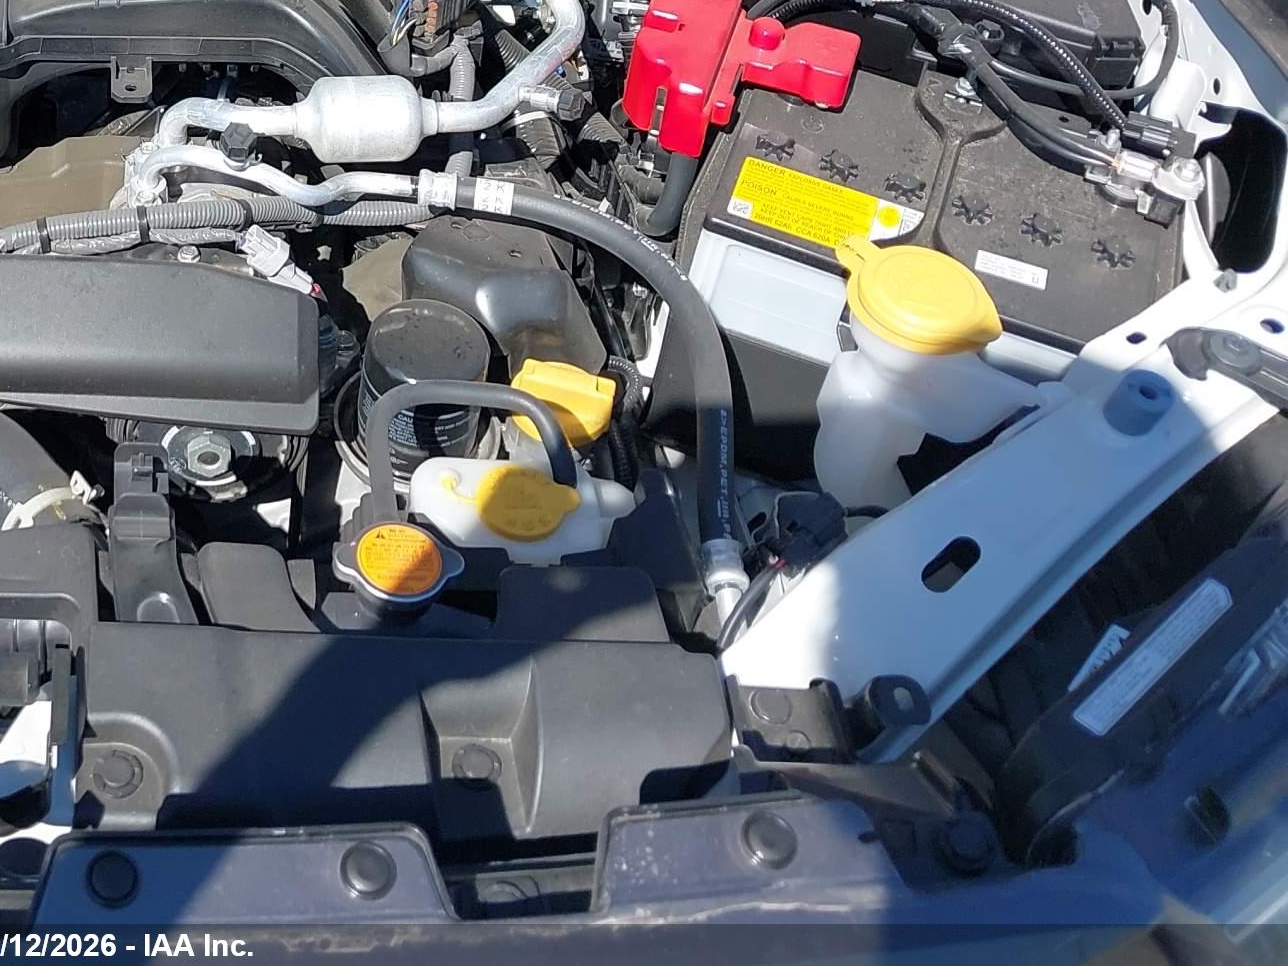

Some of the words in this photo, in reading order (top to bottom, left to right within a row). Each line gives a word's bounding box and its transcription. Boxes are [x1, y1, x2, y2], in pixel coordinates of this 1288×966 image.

[747, 158, 786, 176] DANGER
[740, 178, 777, 196] POISON
[776, 212, 790, 221] OUT
[794, 225, 812, 236] CCA
